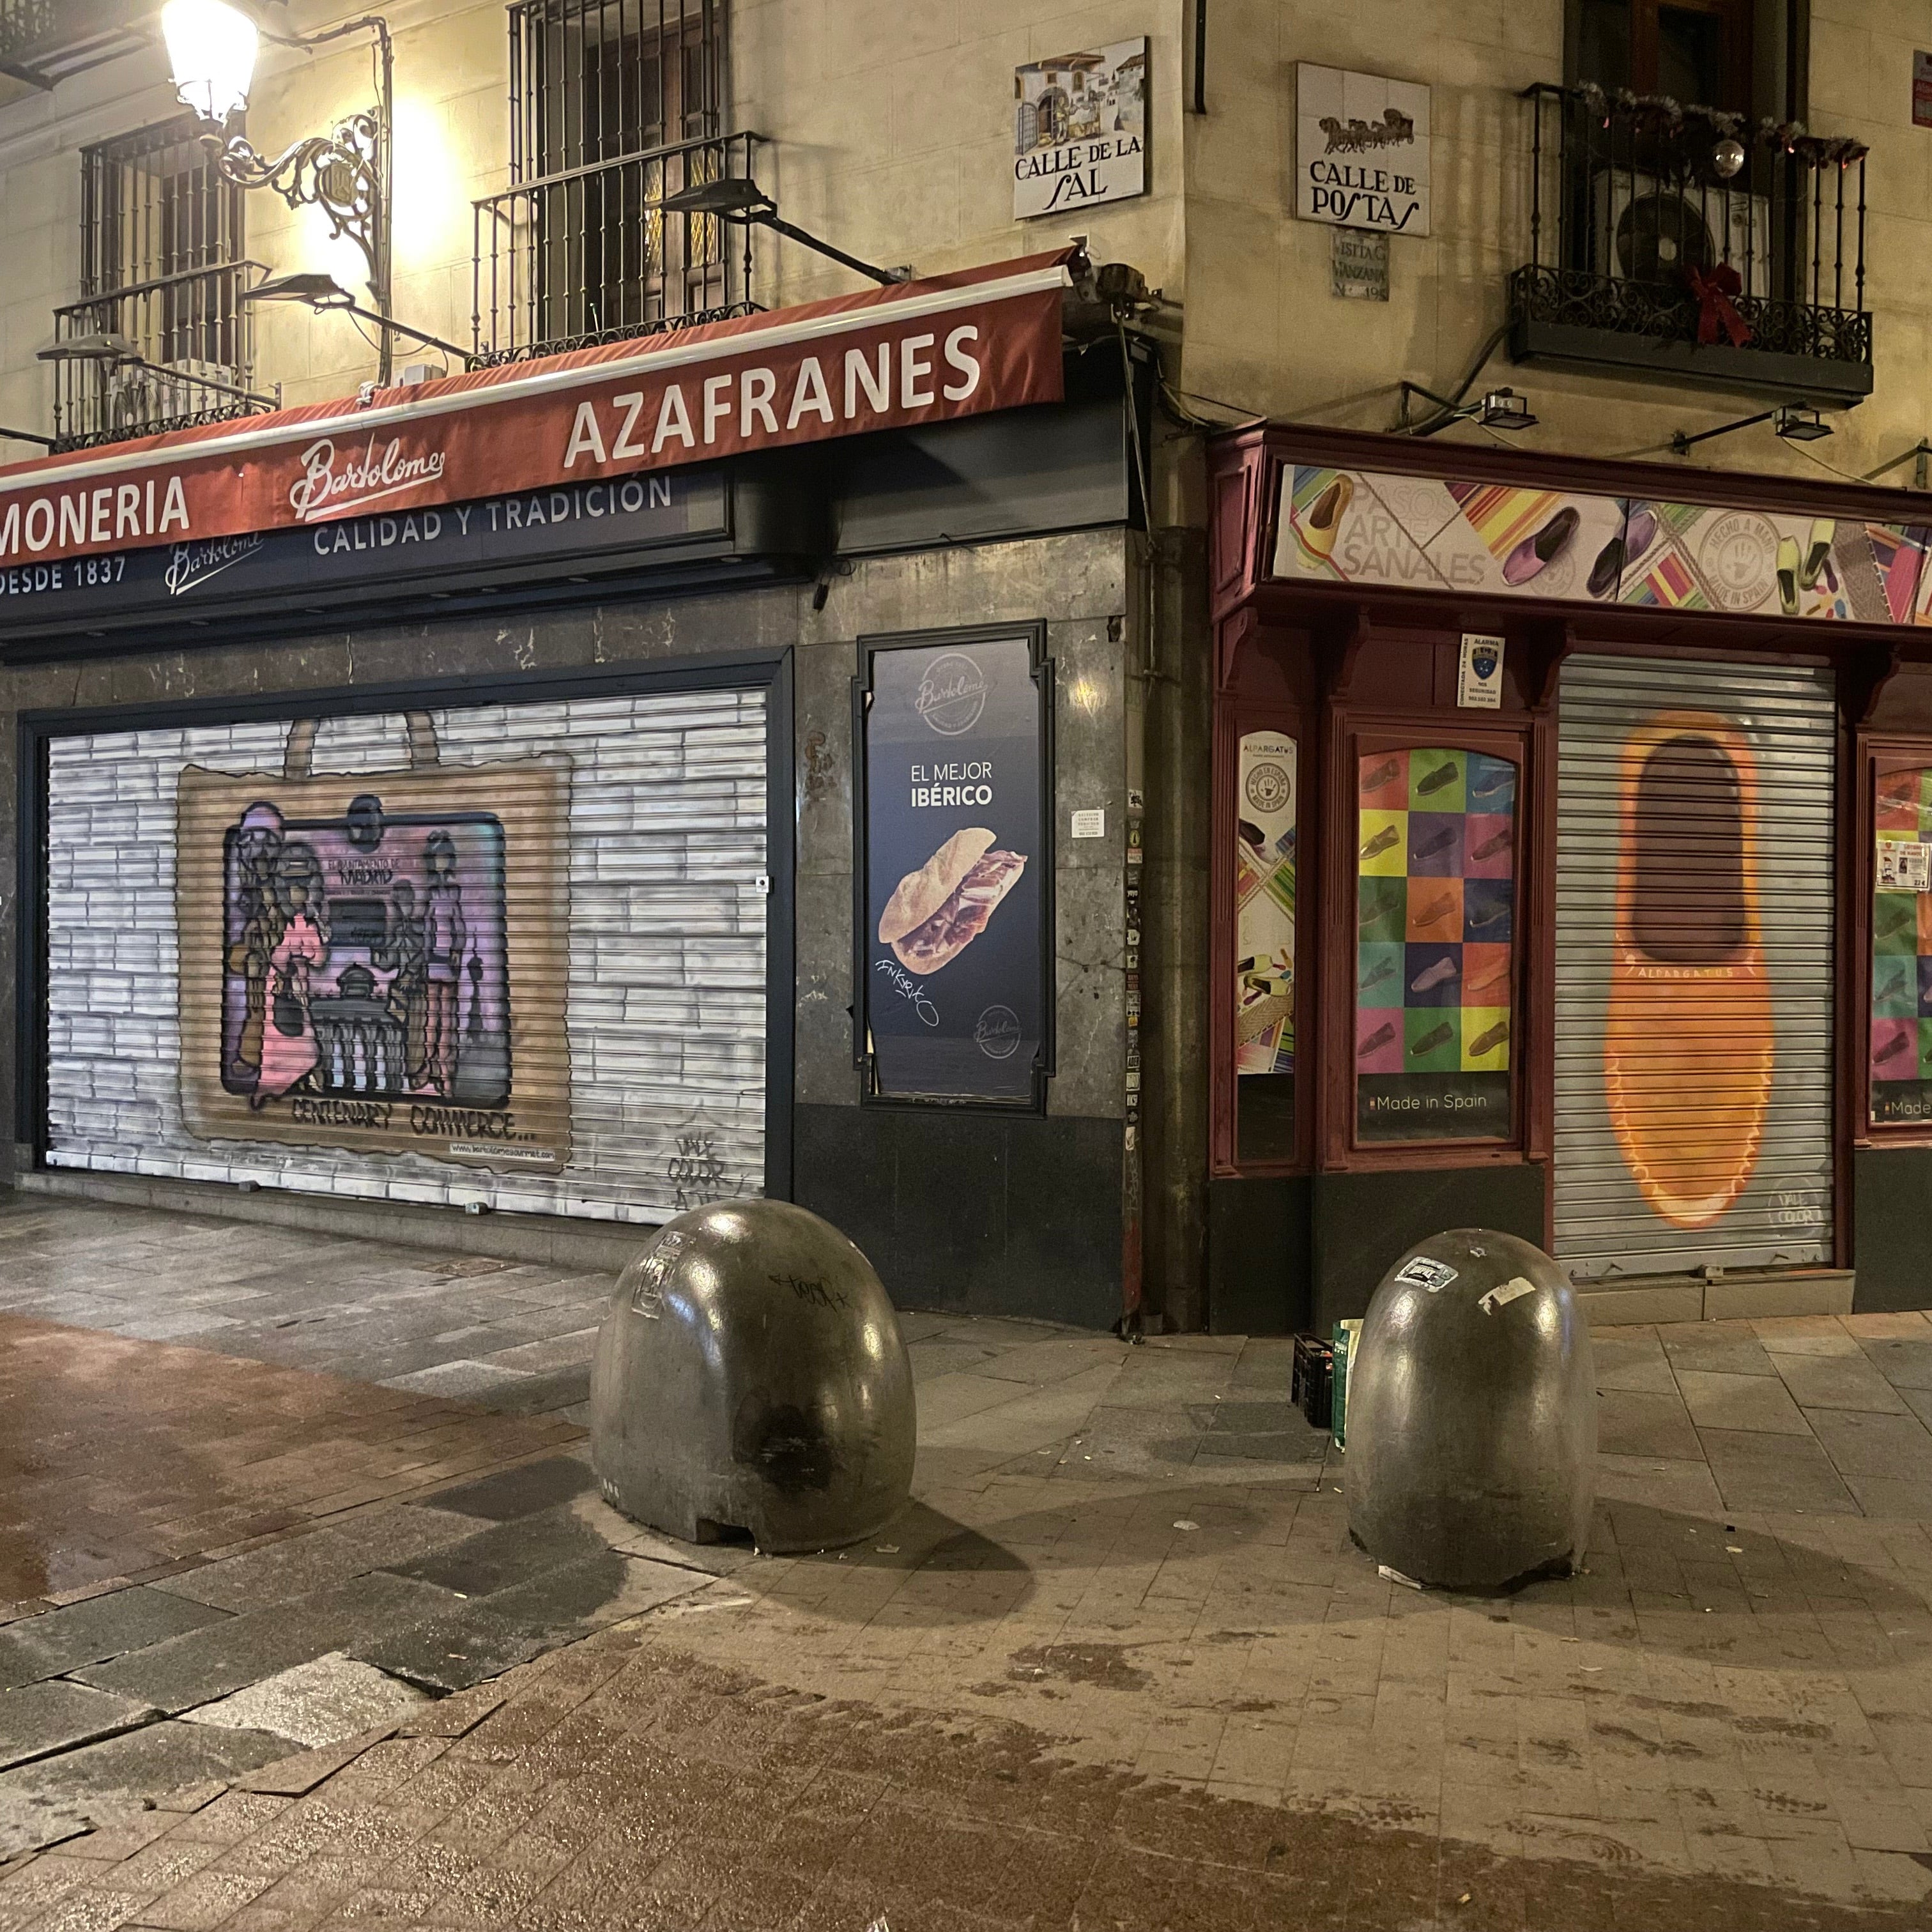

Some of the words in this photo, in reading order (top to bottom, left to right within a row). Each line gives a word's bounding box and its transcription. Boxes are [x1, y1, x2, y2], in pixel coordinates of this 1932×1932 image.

[1015, 146, 1082, 180] CALLE
[1089, 142, 1112, 163] DE
[1116, 136, 1143, 157] LA
[1042, 168, 1108, 210] SAL
[1310, 160, 1390, 193] CALLE
[1393, 174, 1416, 195] DE
[1311, 186, 1420, 231] POSTAS
[563, 325, 981, 469] AZAFRANES
[314, 512, 442, 556] CALIDAD
[456, 505, 471, 535] Y
[486, 471, 672, 532] TRADICIÓN
[1351, 482, 1455, 518] PASOS
[1344, 514, 1429, 547] ARTE
[1709, 518, 1739, 550] HECHO
[1744, 518, 1751, 532] A
[1754, 523, 1775, 554] MANO
[74, 556, 126, 586] 1837
[1343, 544, 1487, 585] SANALES
[1708, 574, 1729, 603] MADE
[1731, 591, 1742, 605] IN
[1743, 578, 1770, 604] SPAIN
[1243, 745, 1294, 754] ALPARGATUS
[911, 765, 930, 782] EL
[934, 762, 992, 781] MEJOR
[911, 783, 993, 808] IBÉRICO
[1252, 795, 1265, 808] MADE
[1271, 795, 1284, 808] SPAIN
[292, 1098, 393, 1130] CENTENARY
[1377, 1096, 1420, 1110] Made
[1425, 1095, 1438, 1109] in
[1444, 1094, 1487, 1111] Spain
[1892, 1100, 1931, 1115] Made
